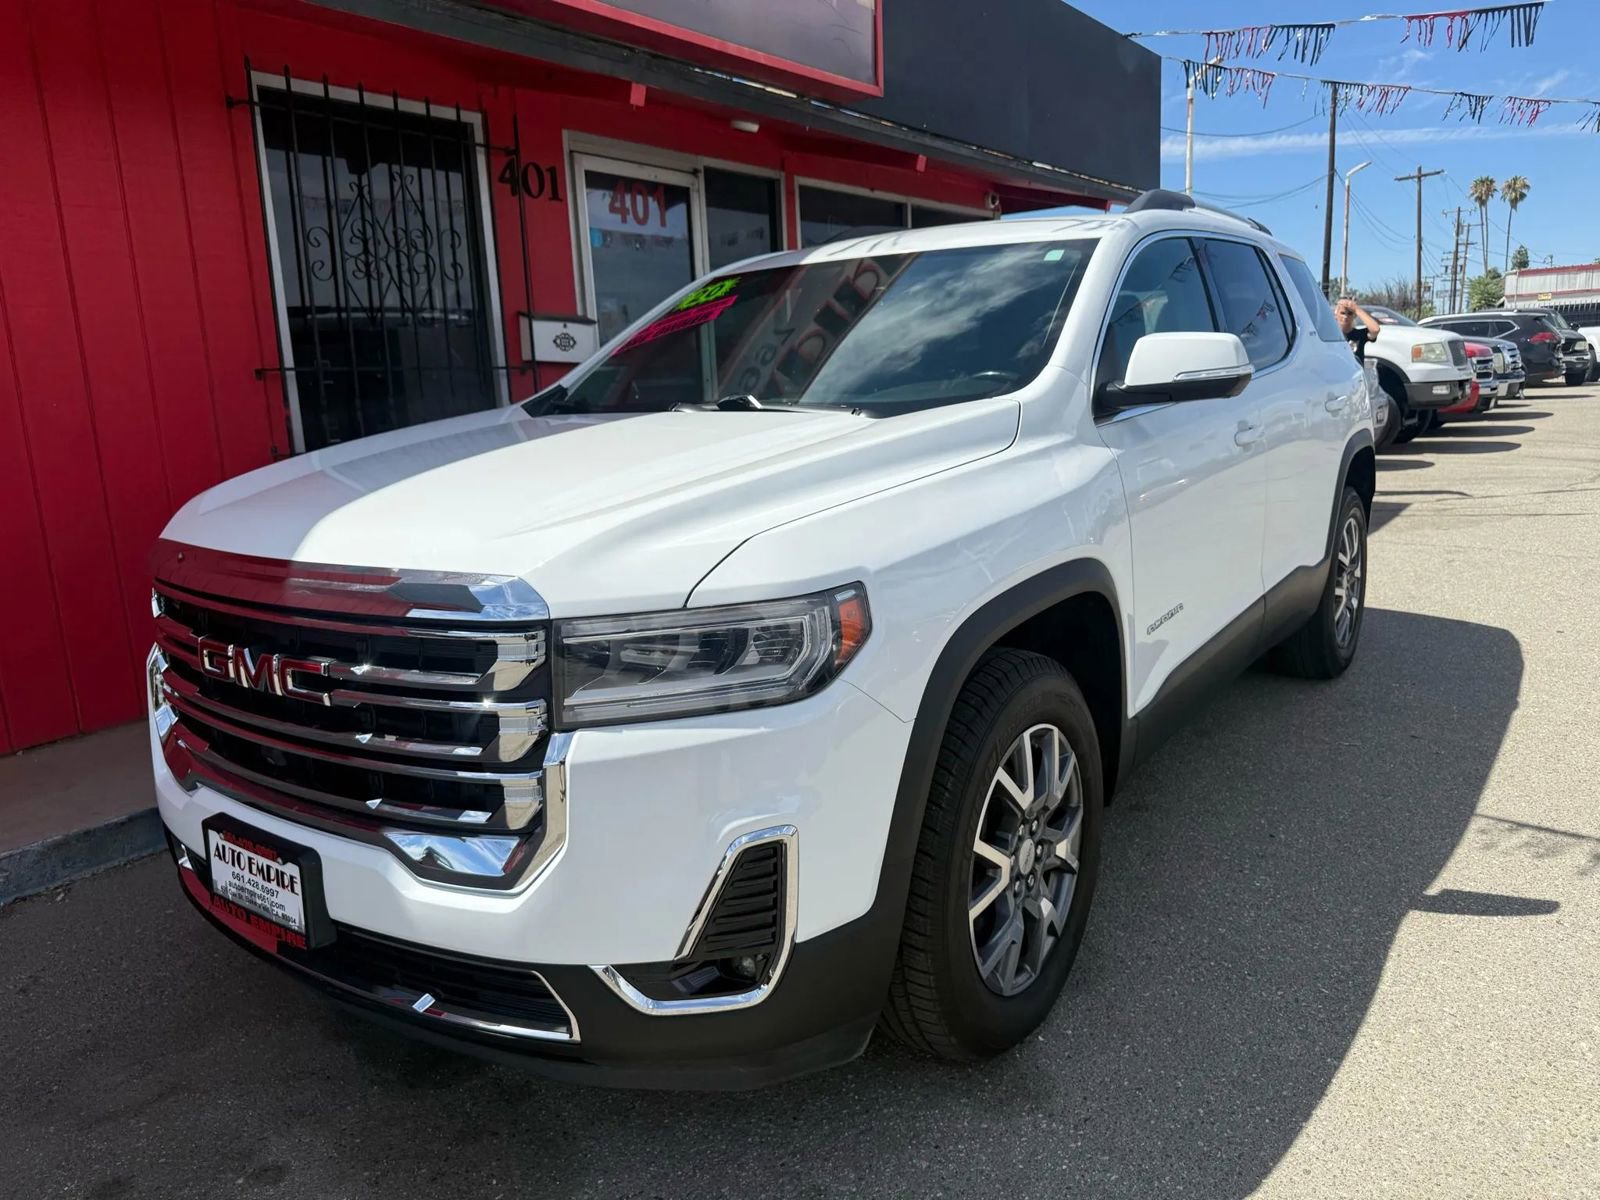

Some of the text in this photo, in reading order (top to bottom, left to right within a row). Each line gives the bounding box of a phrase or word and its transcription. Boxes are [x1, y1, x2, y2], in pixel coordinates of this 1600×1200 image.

[498, 157, 563, 202] 401
[608, 180, 668, 228] 401
[199, 641, 331, 707] GMC
[213, 842, 246, 871] AUTO
[248, 856, 299, 896] EMPIRE
